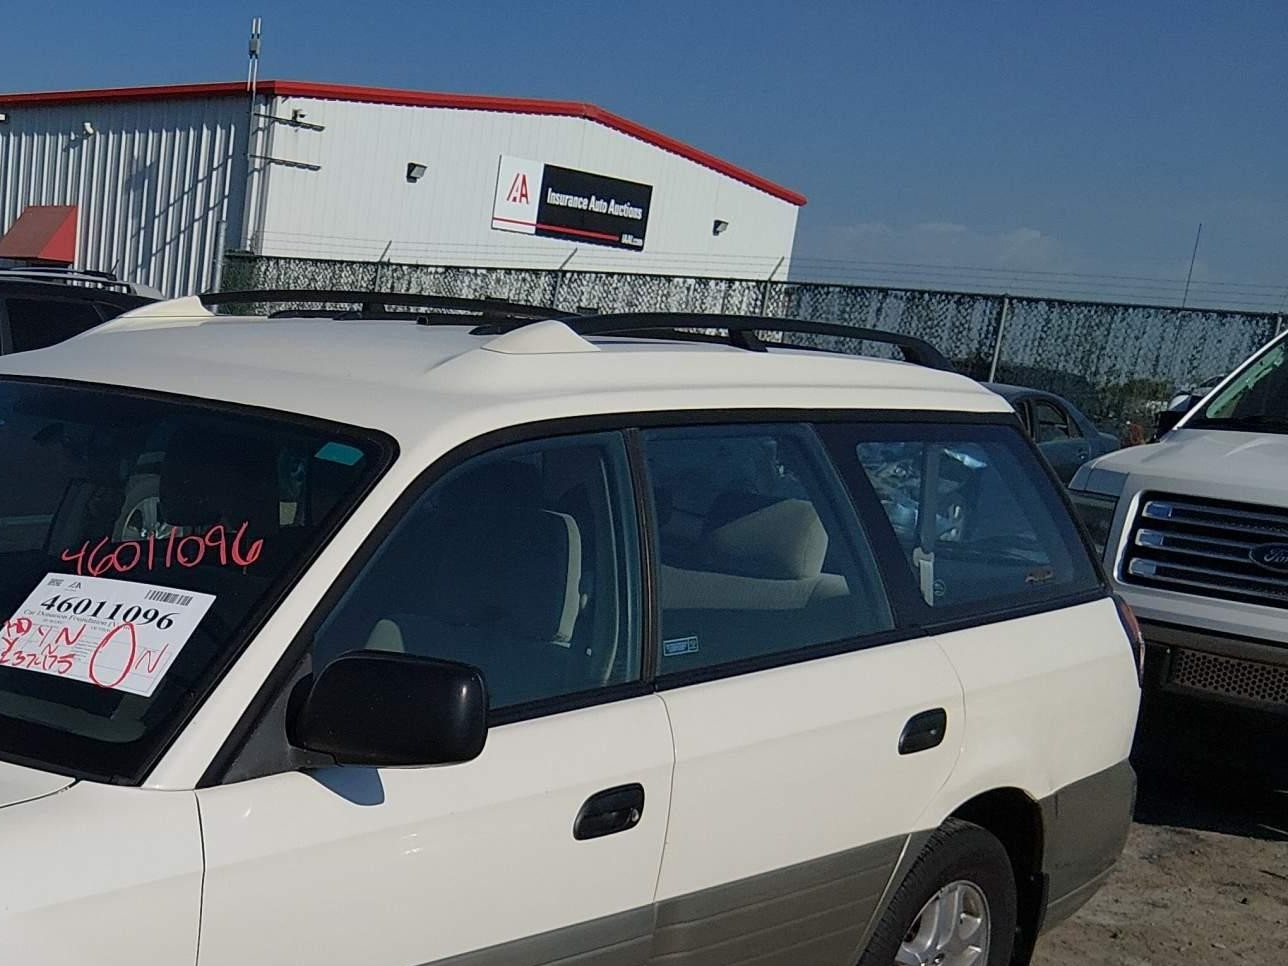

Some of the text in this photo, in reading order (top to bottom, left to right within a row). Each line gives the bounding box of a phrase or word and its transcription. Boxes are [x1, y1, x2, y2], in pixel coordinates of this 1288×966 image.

[546, 187, 643, 221] Insurance Auto Auctions
[61, 521, 264, 577] 46011096
[40, 594, 181, 631] 46011096
